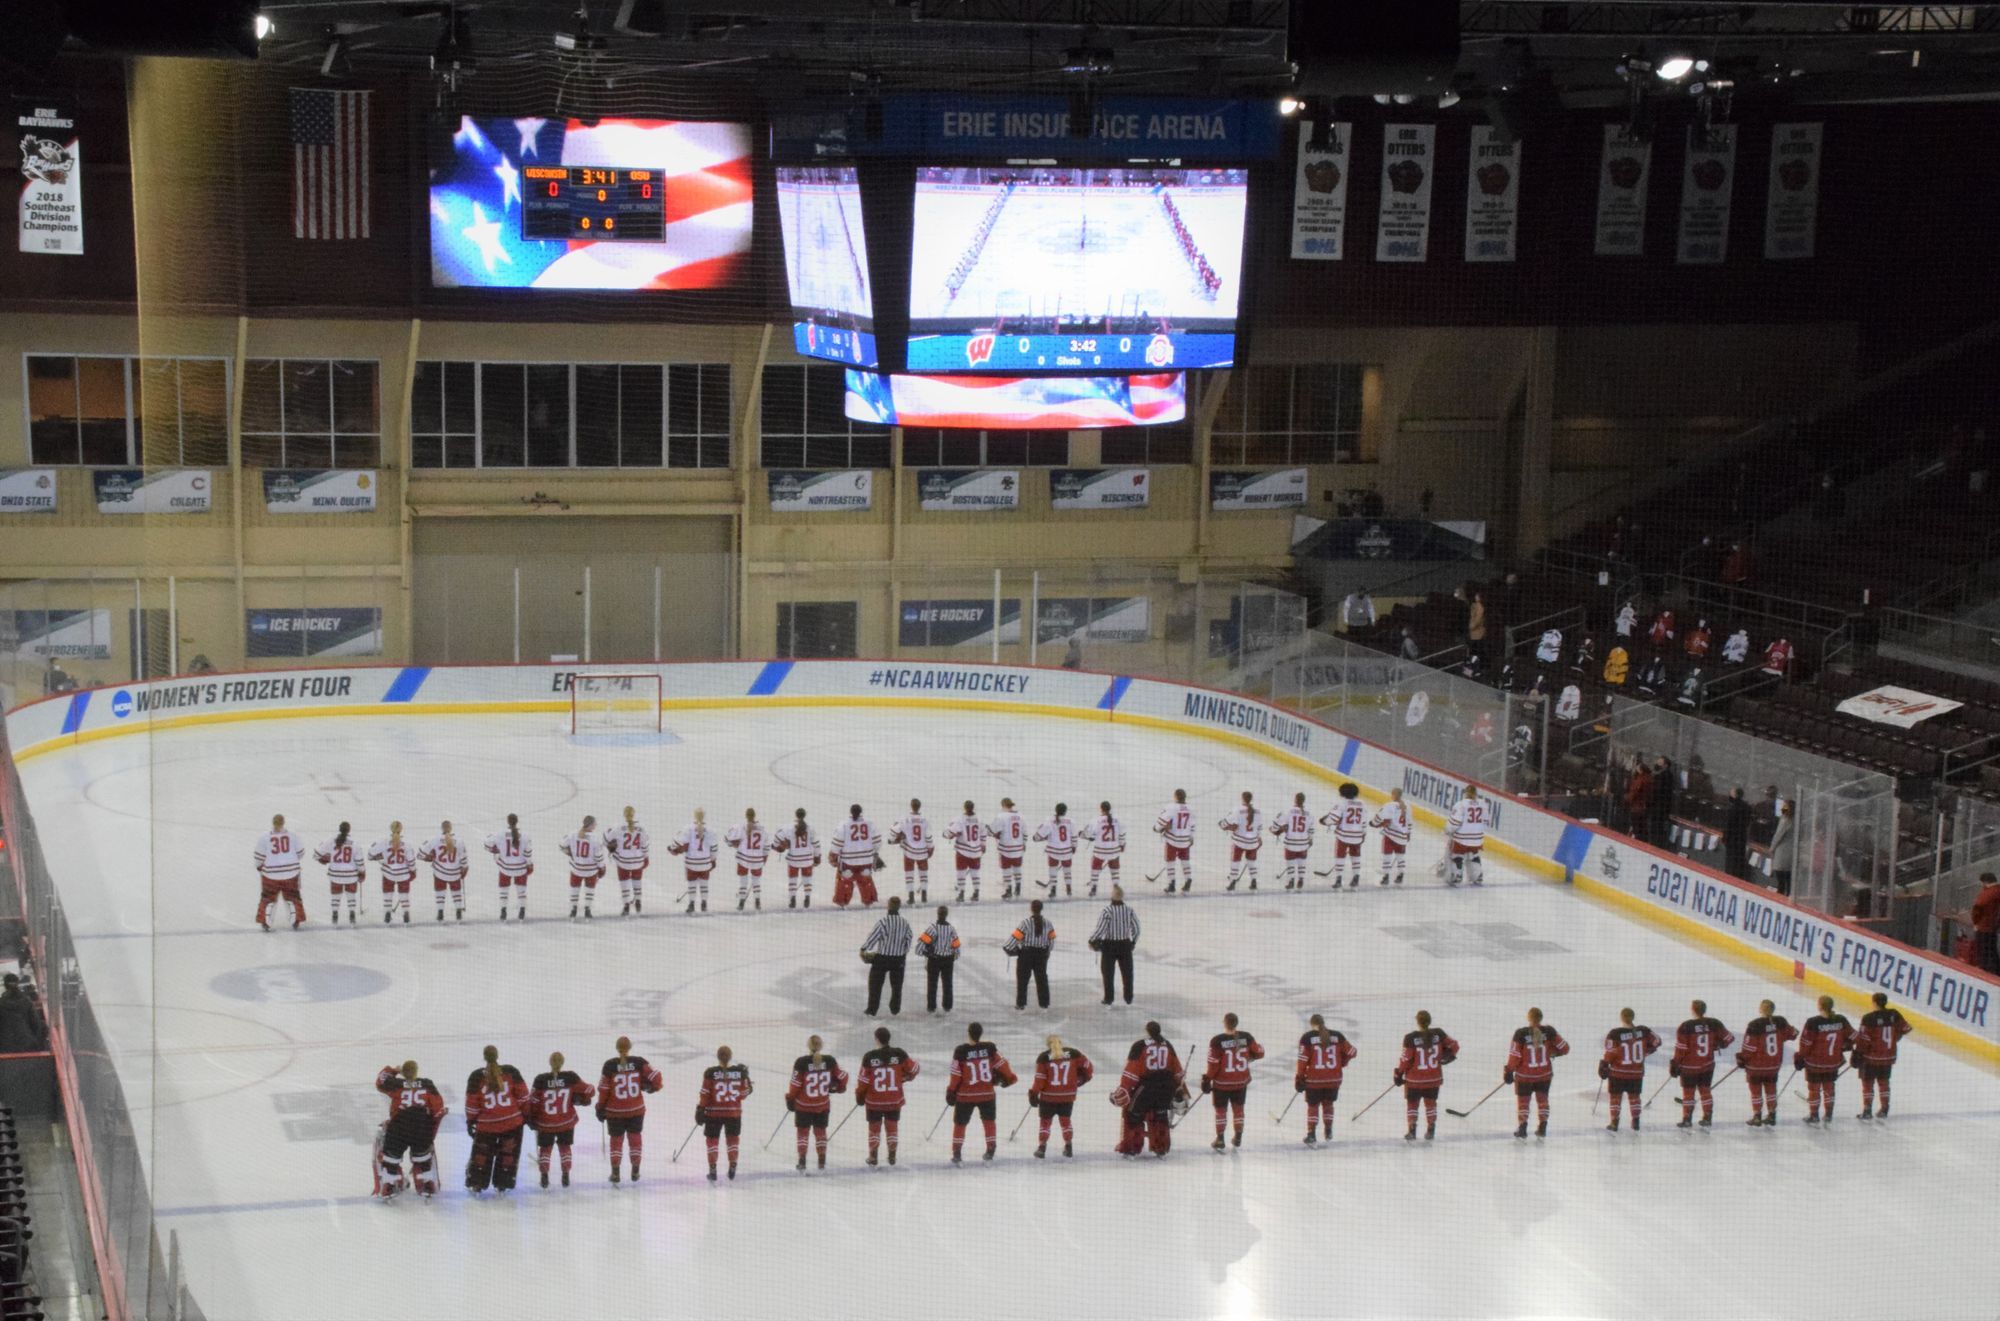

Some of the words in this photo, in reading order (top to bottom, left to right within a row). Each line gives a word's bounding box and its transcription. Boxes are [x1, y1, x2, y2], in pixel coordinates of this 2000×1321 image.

[18, 116, 73, 128] BAYHAWKS
[34, 108, 57, 118] ERIE
[943, 112, 996, 137] ERIE
[1004, 112, 1139, 139] INSURNCE
[1146, 115, 1226, 140] ARENA
[583, 169, 615, 185] 3:41
[630, 170, 650, 181] OSU
[36, 192, 64, 202] 2018
[549, 181, 559, 197] 0
[598, 189, 607, 202] 0
[642, 183, 652, 199] 0
[25, 202, 76, 213] Southeast
[30, 211, 71, 222] Division
[23, 221, 79, 233] Champions
[1018, 337, 1031, 353] 0
[1069, 338, 1097, 352] 3:42
[1119, 337, 1131, 353] 0
[1056, 355, 1082, 367] Shots
[28, 495, 53, 508] STATE
[170, 496, 208, 509] COLGATE
[808, 495, 868, 506] NORTHEASTERN
[951, 494, 983, 506] BOSTON
[983, 494, 1015, 506] COLLEGE
[940, 607, 984, 622] HOCKEY
[270, 616, 291, 632] ICE
[292, 616, 341, 632] HOCKEY
[869, 669, 1029, 694] #NCAAWHOCKEY
[136, 683, 217, 713] WOMEN'S
[221, 676, 293, 704] FROZEN
[299, 675, 352, 699] FOUR
[1184, 692, 1268, 732] MINNESOTA
[1270, 713, 1310, 752] DULUTH
[1403, 766, 1502, 831] NORTHEAN
[1176, 812, 1191, 830] 17
[1291, 815, 1306, 833] 15
[1346, 806, 1363, 825] 25
[1466, 806, 1483, 824] 32
[850, 823, 869, 842] 29
[912, 824, 922, 842] 9
[964, 824, 979, 842] 16
[1010, 822, 1020, 839] 6
[1058, 824, 1068, 842] 8
[270, 835, 290, 854] 30
[575, 839, 590, 858] 10
[623, 832, 642, 850] 24
[747, 831, 762, 850] 12
[387, 847, 405, 864] 26
[1647, 862, 1689, 907] 2021
[1692, 880, 1737, 927] NCAA
[1743, 899, 1836, 965] WOMEN'S
[1840, 938, 1924, 1006] FROZEN
[1927, 971, 1990, 1028] FOUR
[1697, 1033, 1710, 1057] 9
[1765, 1032, 1778, 1057] 8
[1826, 1032, 1838, 1056] 7
[1882, 1025, 1892, 1050] 4
[1145, 1045, 1169, 1070] 20
[1224, 1049, 1249, 1073] 15
[1314, 1045, 1338, 1070] 13
[1416, 1046, 1439, 1071] 12
[1526, 1045, 1548, 1069] 11
[1620, 1039, 1644, 1065] 10
[873, 1067, 899, 1093] 21
[966, 1059, 993, 1086] 18
[1050, 1061, 1071, 1086] 17
[614, 1072, 640, 1100] 26
[805, 1071, 832, 1098] 22
[543, 1088, 571, 1115] 27
